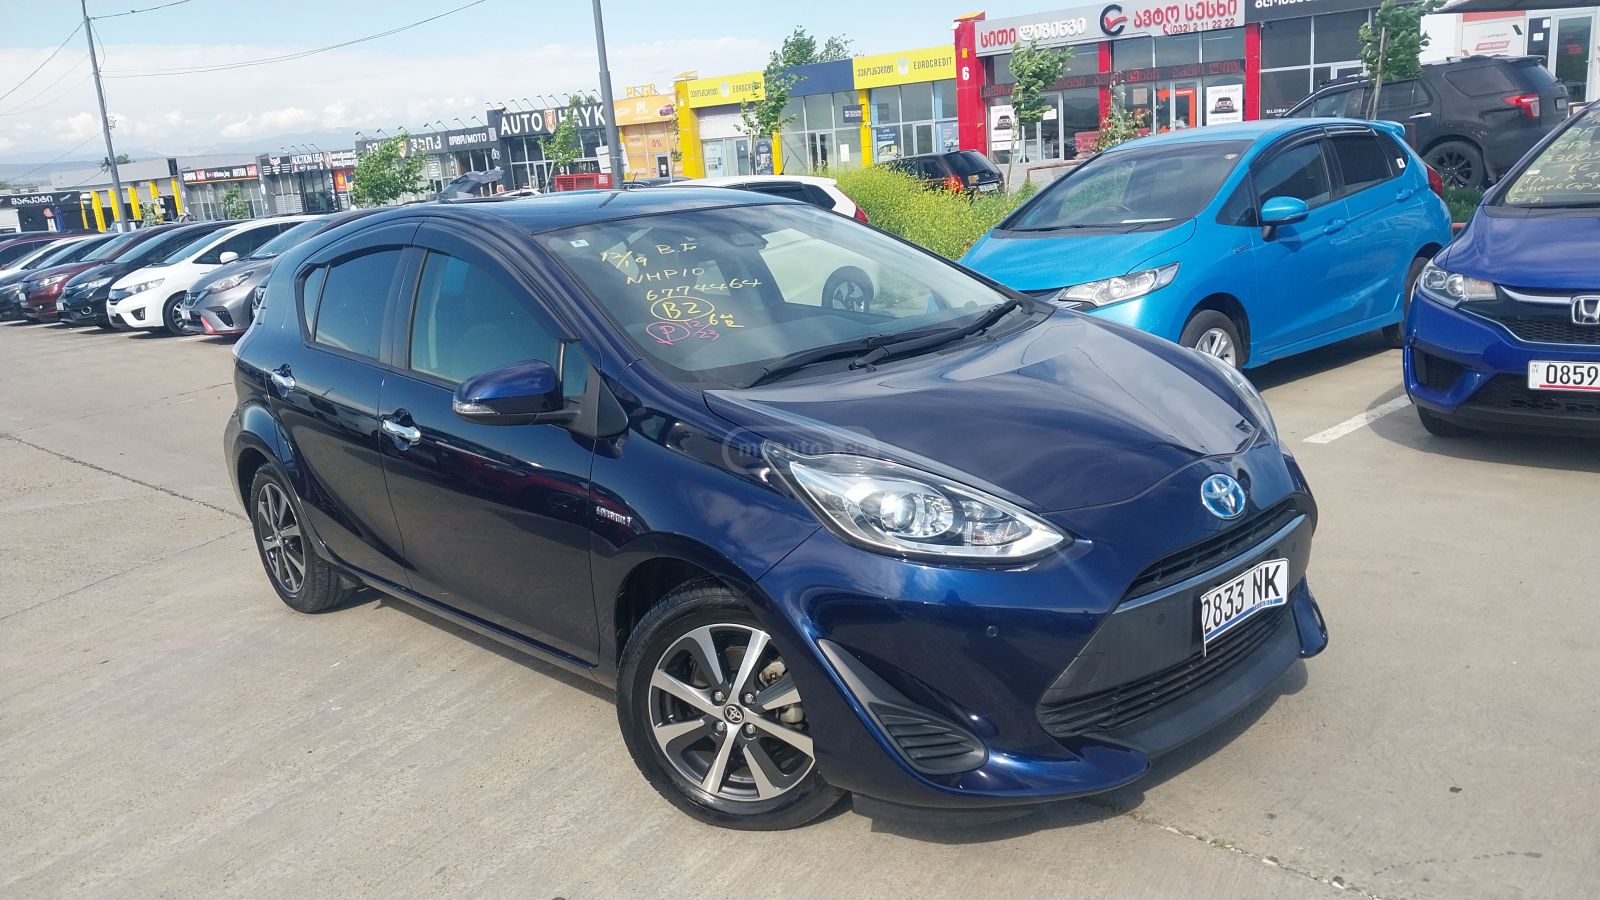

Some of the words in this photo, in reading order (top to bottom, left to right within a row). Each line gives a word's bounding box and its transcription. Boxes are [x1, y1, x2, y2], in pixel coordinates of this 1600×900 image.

[1134, 5, 1180, 28] ავტო
[1185, 0, 1238, 21] სესხი
[980, 27, 1016, 48] სითი
[1019, 18, 1086, 41] ლიზინგი
[1170, 22, 1191, 34] (032)
[1193, 23, 1198, 32] 2
[1201, 21, 1209, 31] 11
[1212, 19, 1222, 29] 22
[1225, 18, 1235, 27] 22
[913, 56, 953, 70] EUROCREDIT
[961, 66, 970, 81] 6
[501, 112, 543, 136] AUTO
[558, 105, 606, 128] HAYK
[11, 195, 53, 205] მარკეტი
[626, 268, 705, 285] NHP10
[662, 302, 701, 319] B2
[1545, 364, 1599, 386] 0859
[1203, 578, 1245, 635] 2833
[1252, 564, 1281, 605] NK
